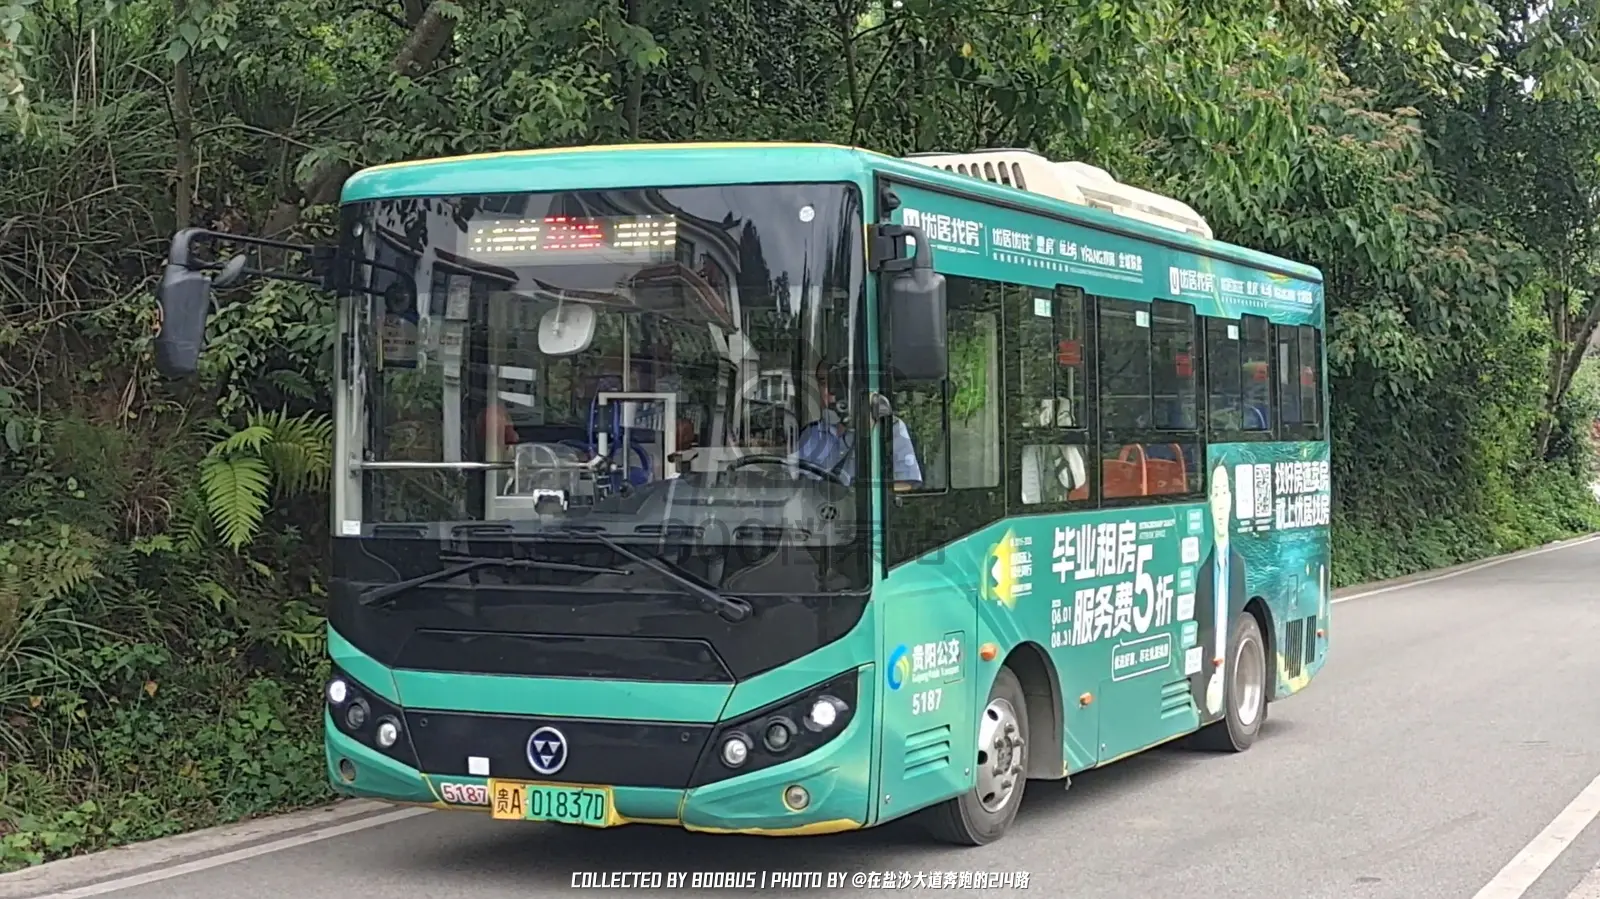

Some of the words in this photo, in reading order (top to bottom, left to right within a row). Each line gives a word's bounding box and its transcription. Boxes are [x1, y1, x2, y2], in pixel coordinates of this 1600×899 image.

[1051, 519, 1137, 584] 毕业租房
[911, 638, 960, 672] 贵阳公交
[911, 687, 943, 716] 5187
[441, 782, 489, 805] 5187
